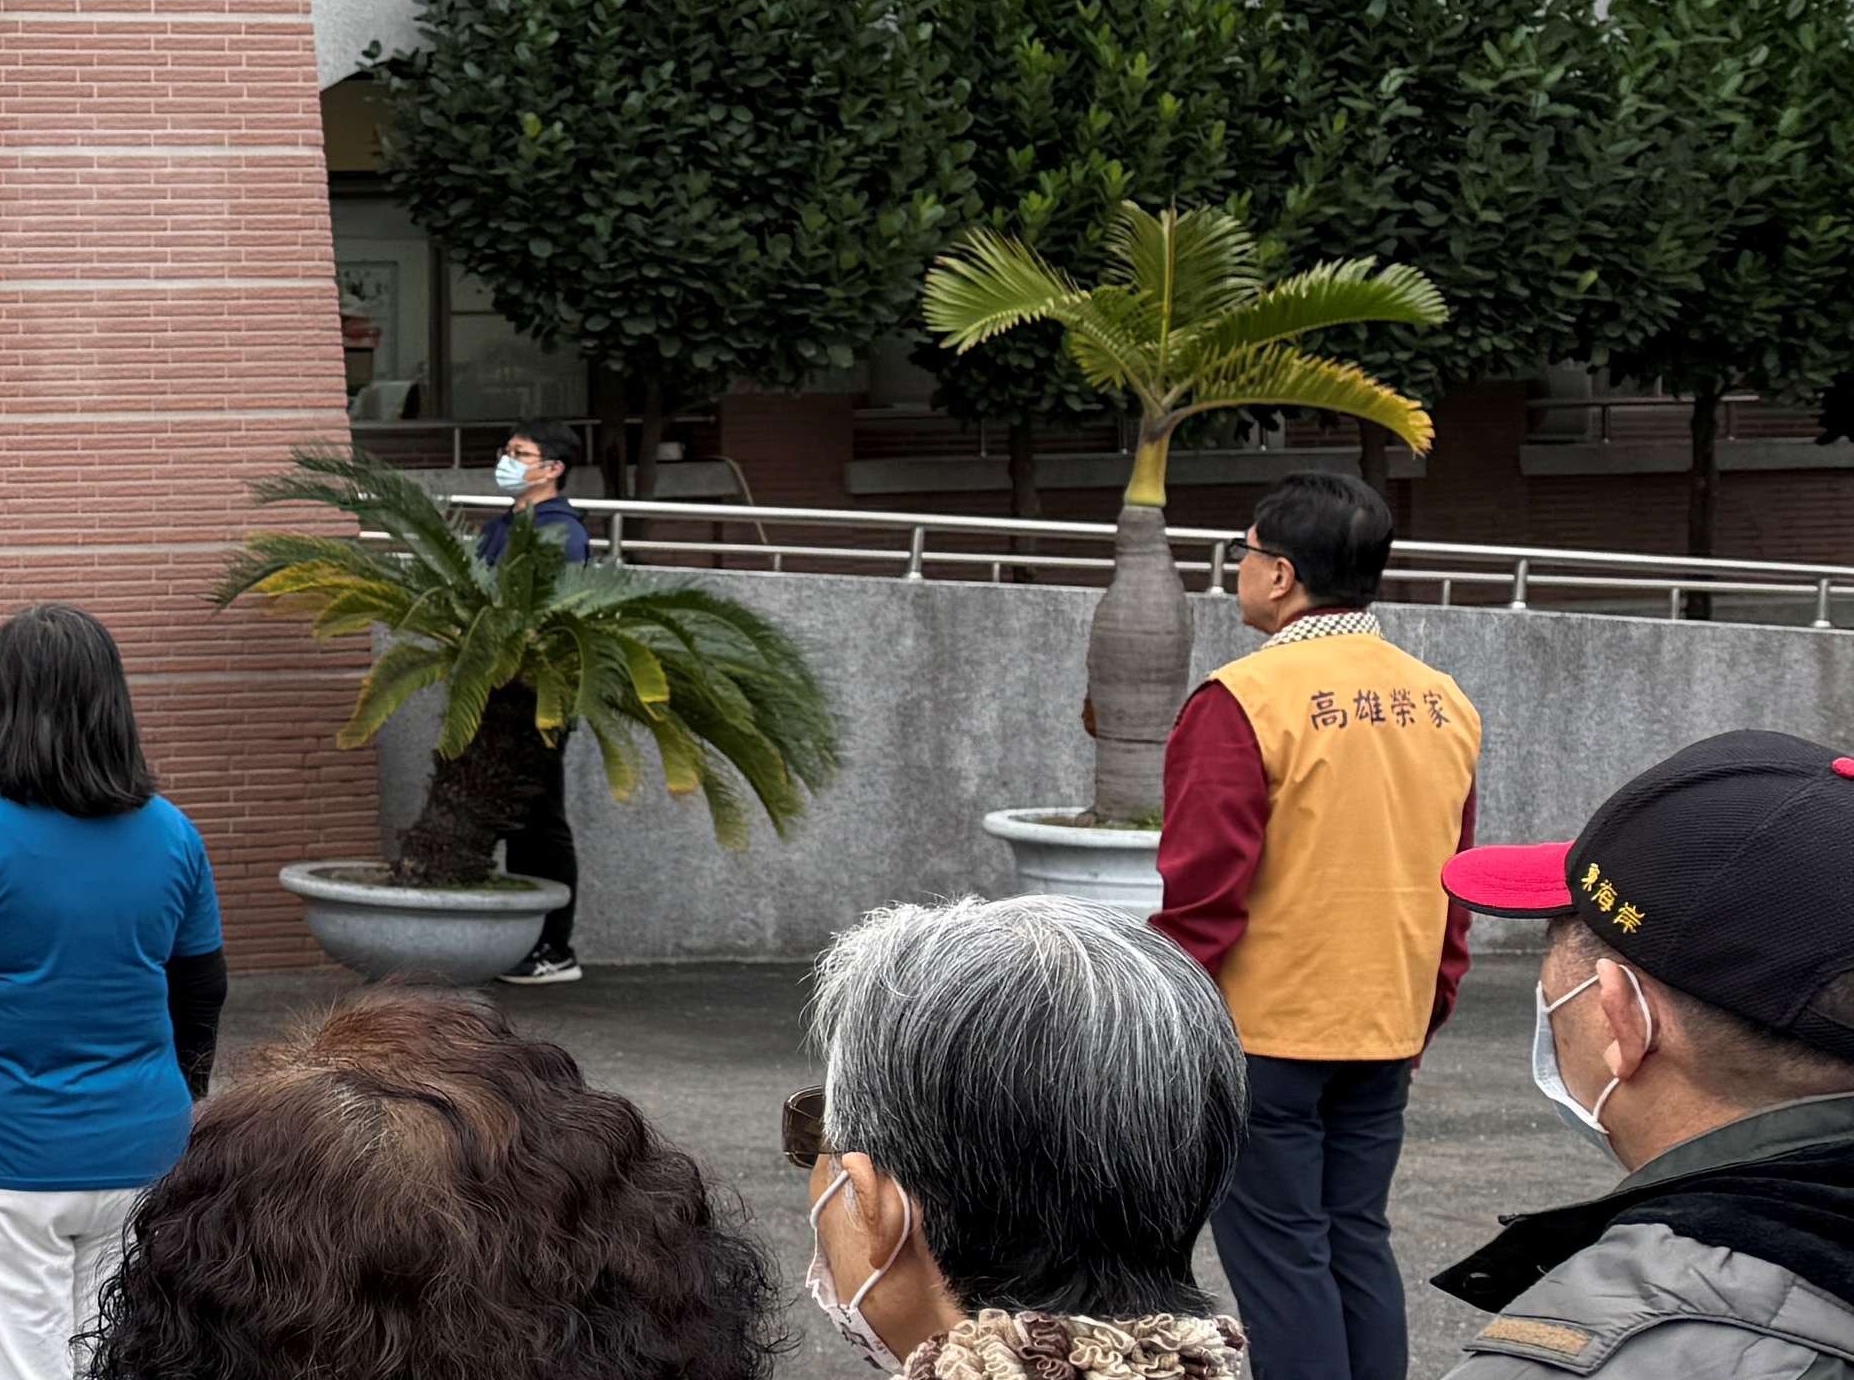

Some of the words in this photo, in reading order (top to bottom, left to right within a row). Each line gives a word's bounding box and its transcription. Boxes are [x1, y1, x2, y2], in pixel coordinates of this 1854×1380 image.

[1309, 689, 1452, 731] 高雄榮家
[1579, 862, 1647, 935] 東海岸
